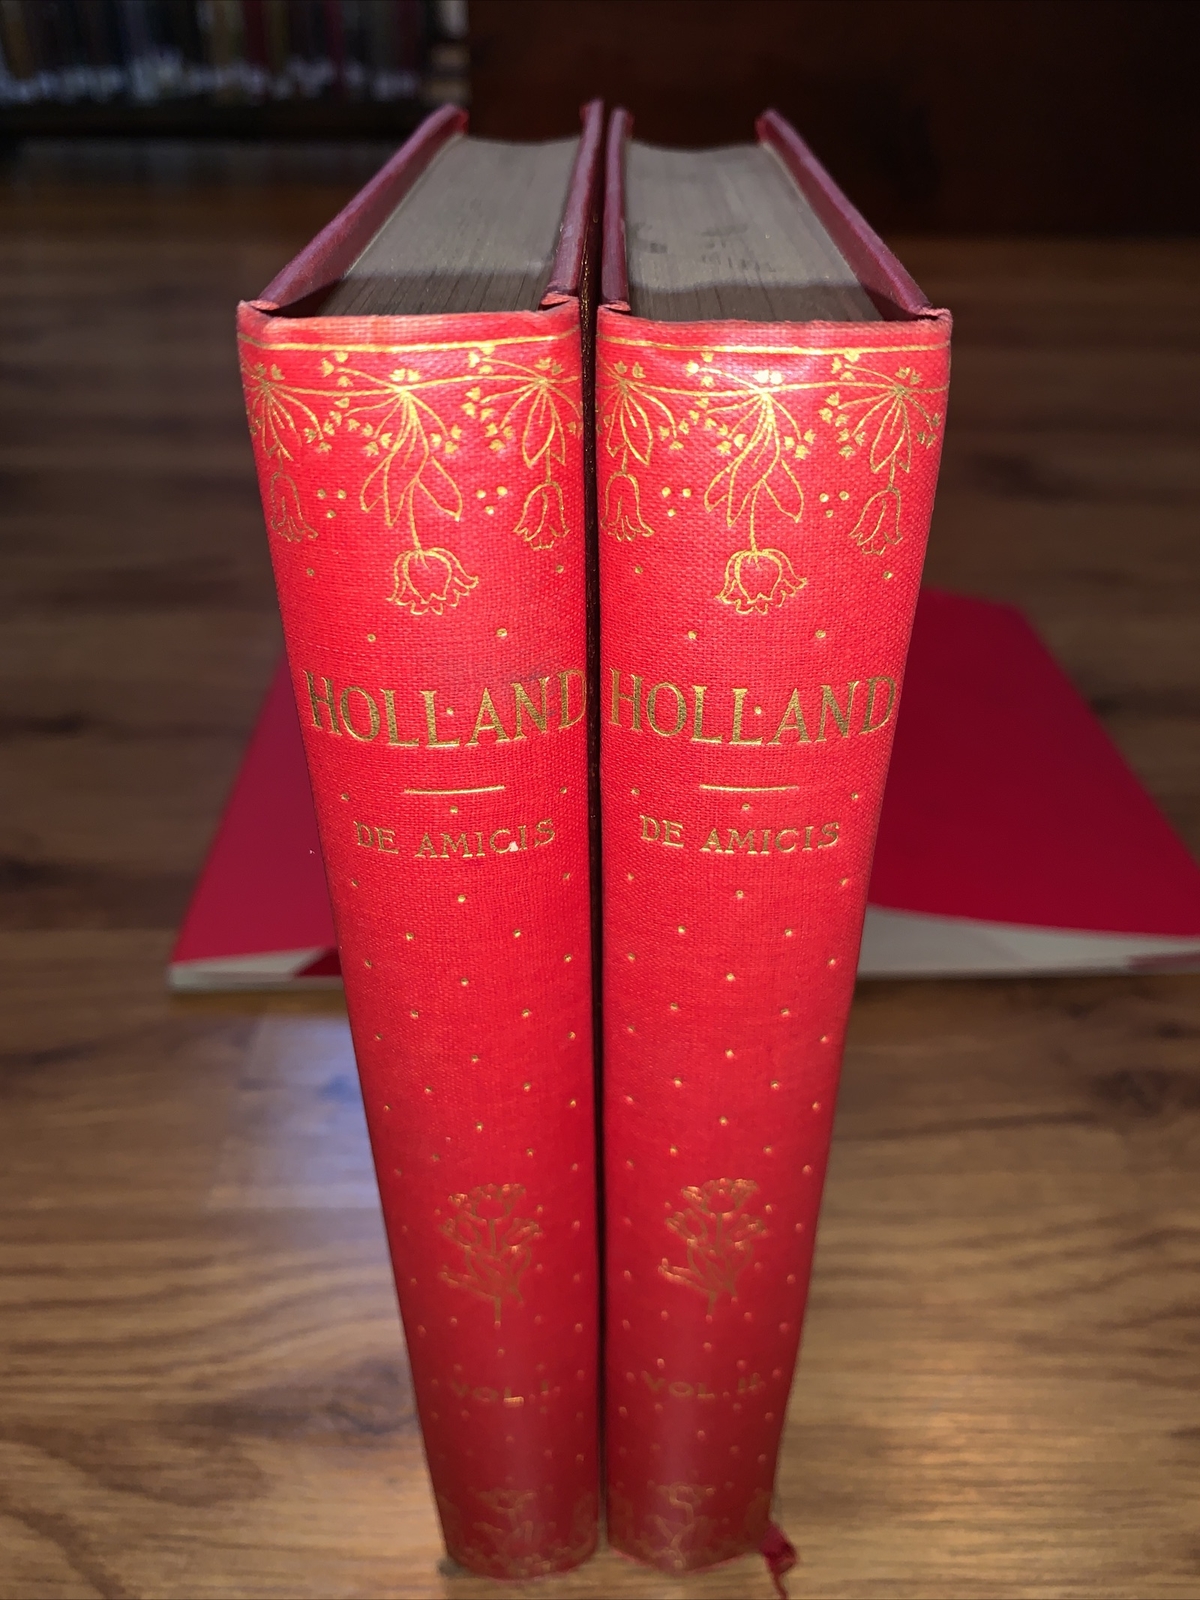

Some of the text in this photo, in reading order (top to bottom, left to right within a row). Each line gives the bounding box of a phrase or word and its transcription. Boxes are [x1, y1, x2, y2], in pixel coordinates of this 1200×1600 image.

[303, 669, 587, 747] HOLLAND
[609, 667, 897, 745] HOLLAND
[353, 819, 556, 858] DE AMICIS
[639, 814, 841, 855] DE AMICIS
